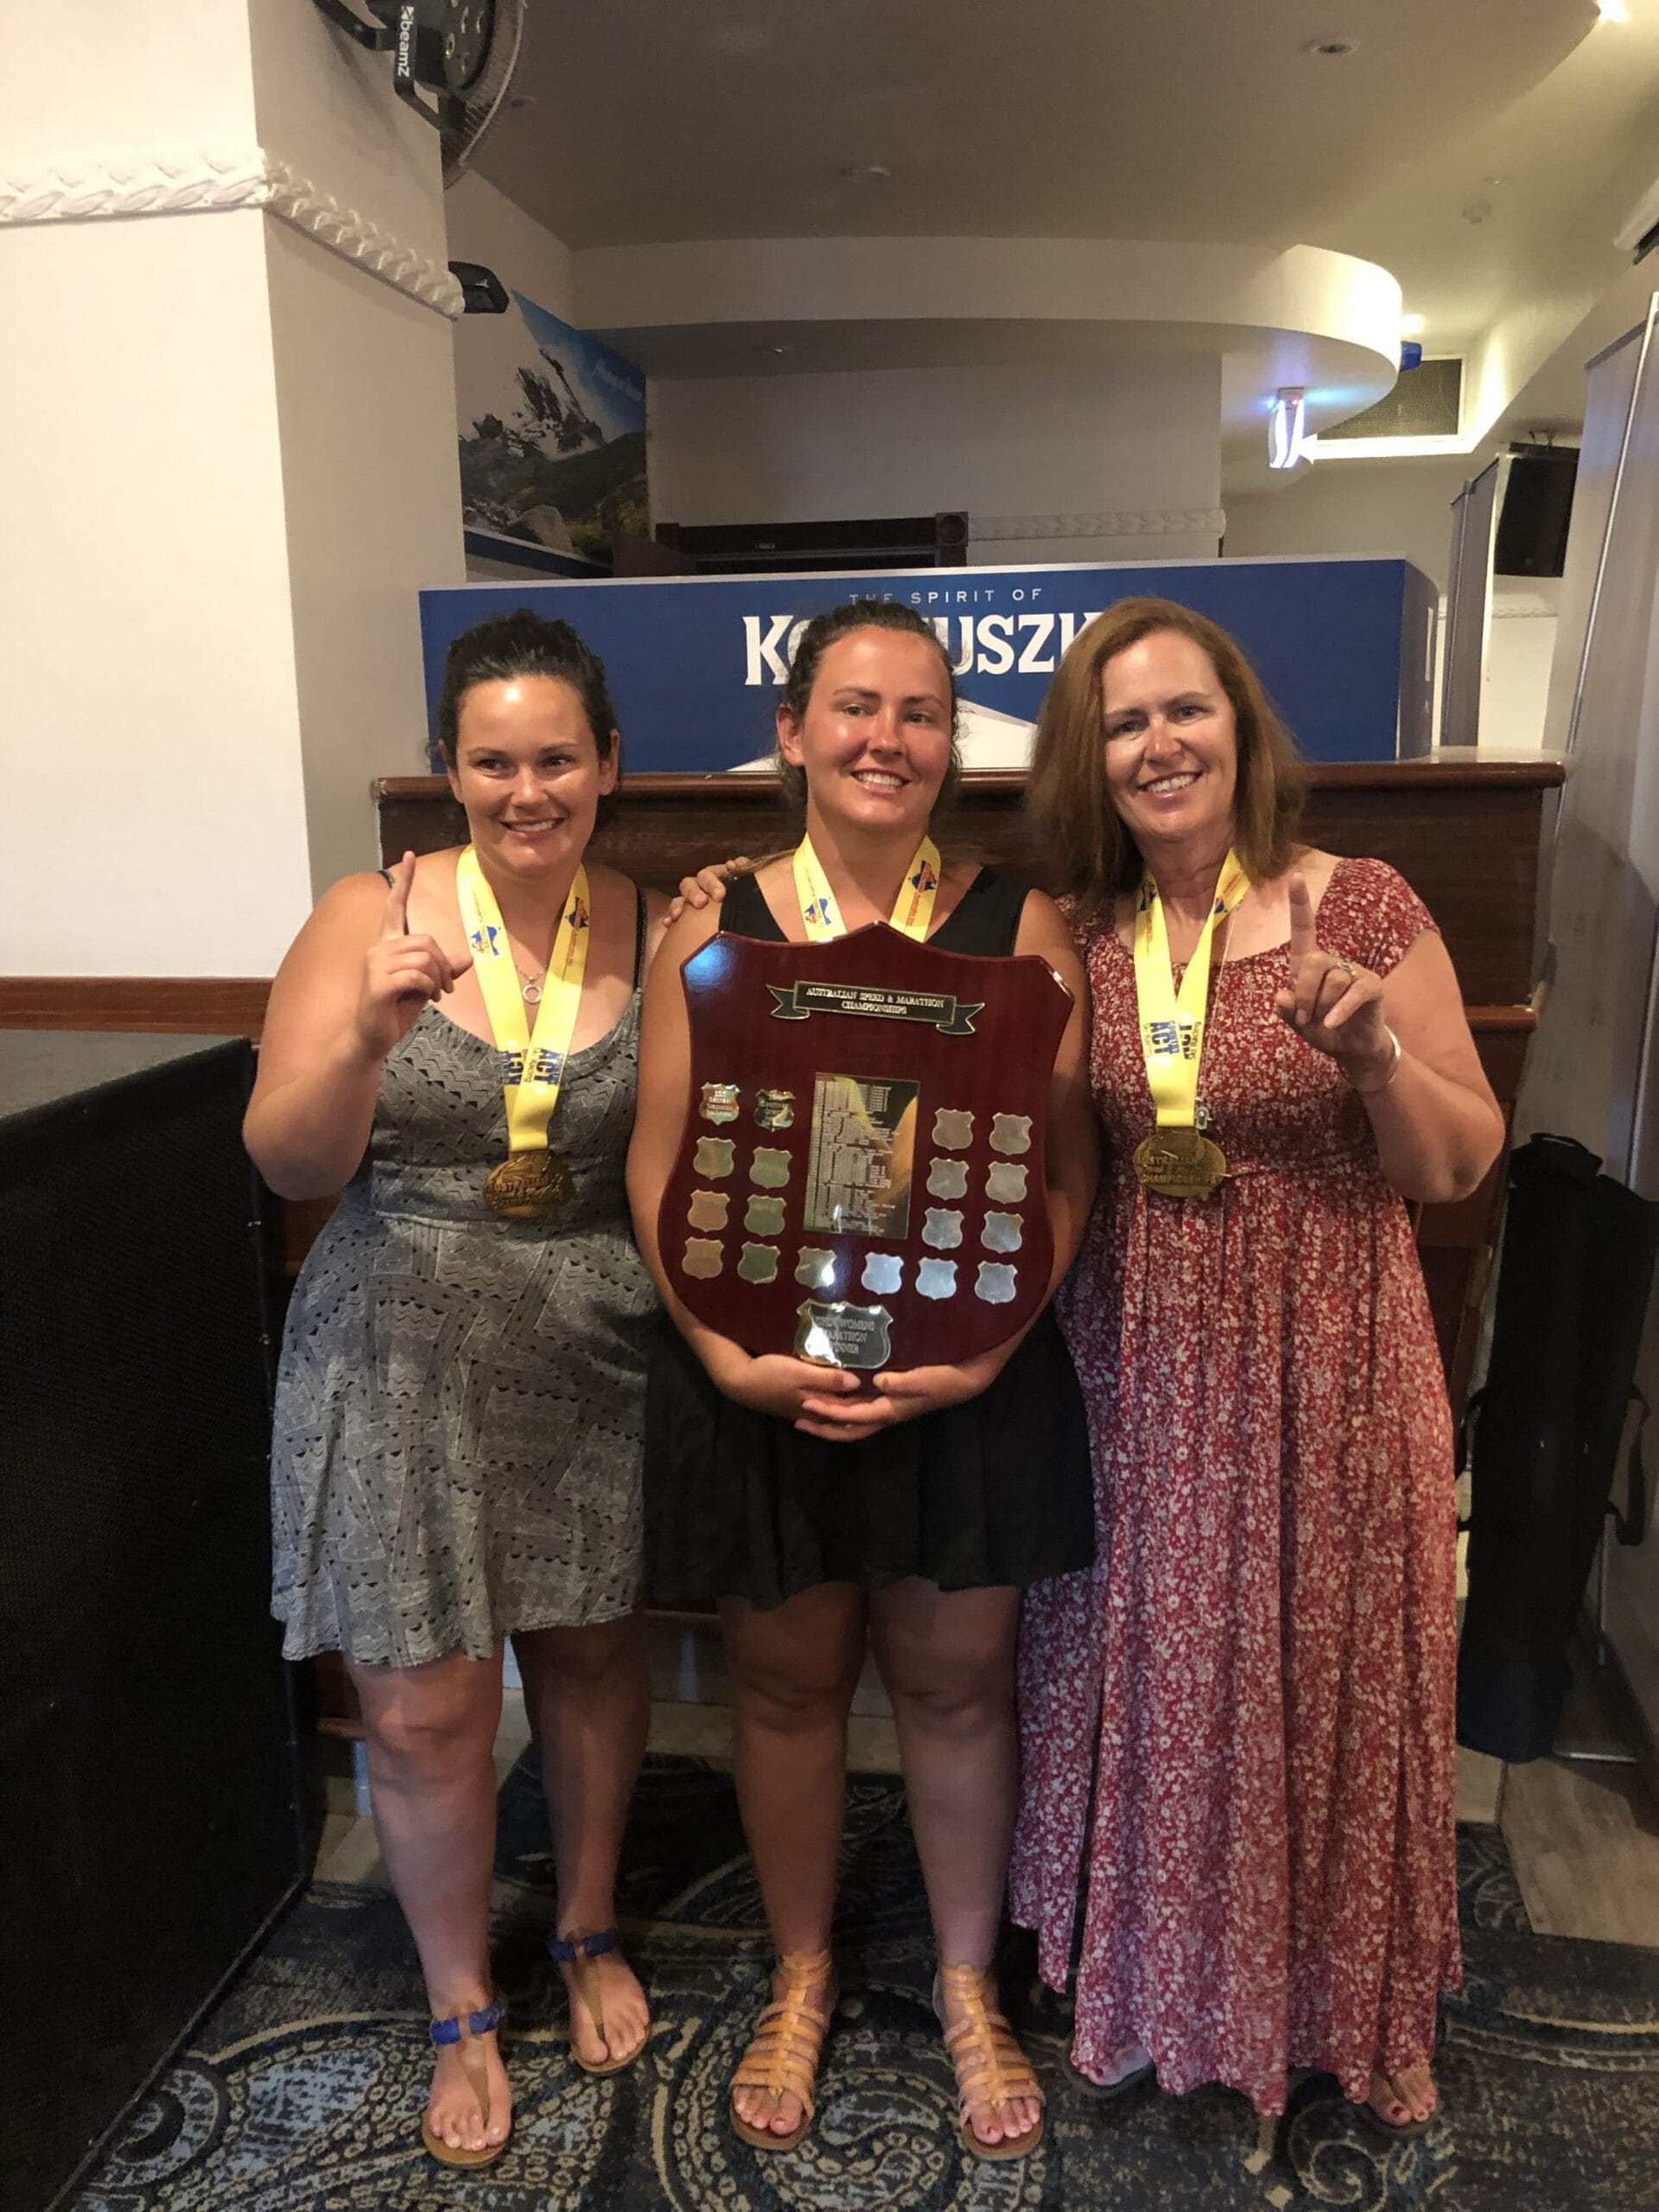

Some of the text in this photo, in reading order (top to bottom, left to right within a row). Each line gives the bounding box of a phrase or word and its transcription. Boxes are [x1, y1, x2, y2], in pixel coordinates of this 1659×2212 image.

[911, 589, 995, 604] SPIRIT
[1012, 588, 1042, 601] OF
[806, 988, 857, 1000] AUSTRALIAN
[859, 993, 885, 1002] SPEED
[896, 996, 944, 1008] MARATHON
[841, 1001, 907, 1014] CHAMPIONSHIPS
[1150, 1022, 1173, 1054] ACT
[1191, 1021, 1202, 1047] Racing
[534, 1049, 562, 1085] ACT
